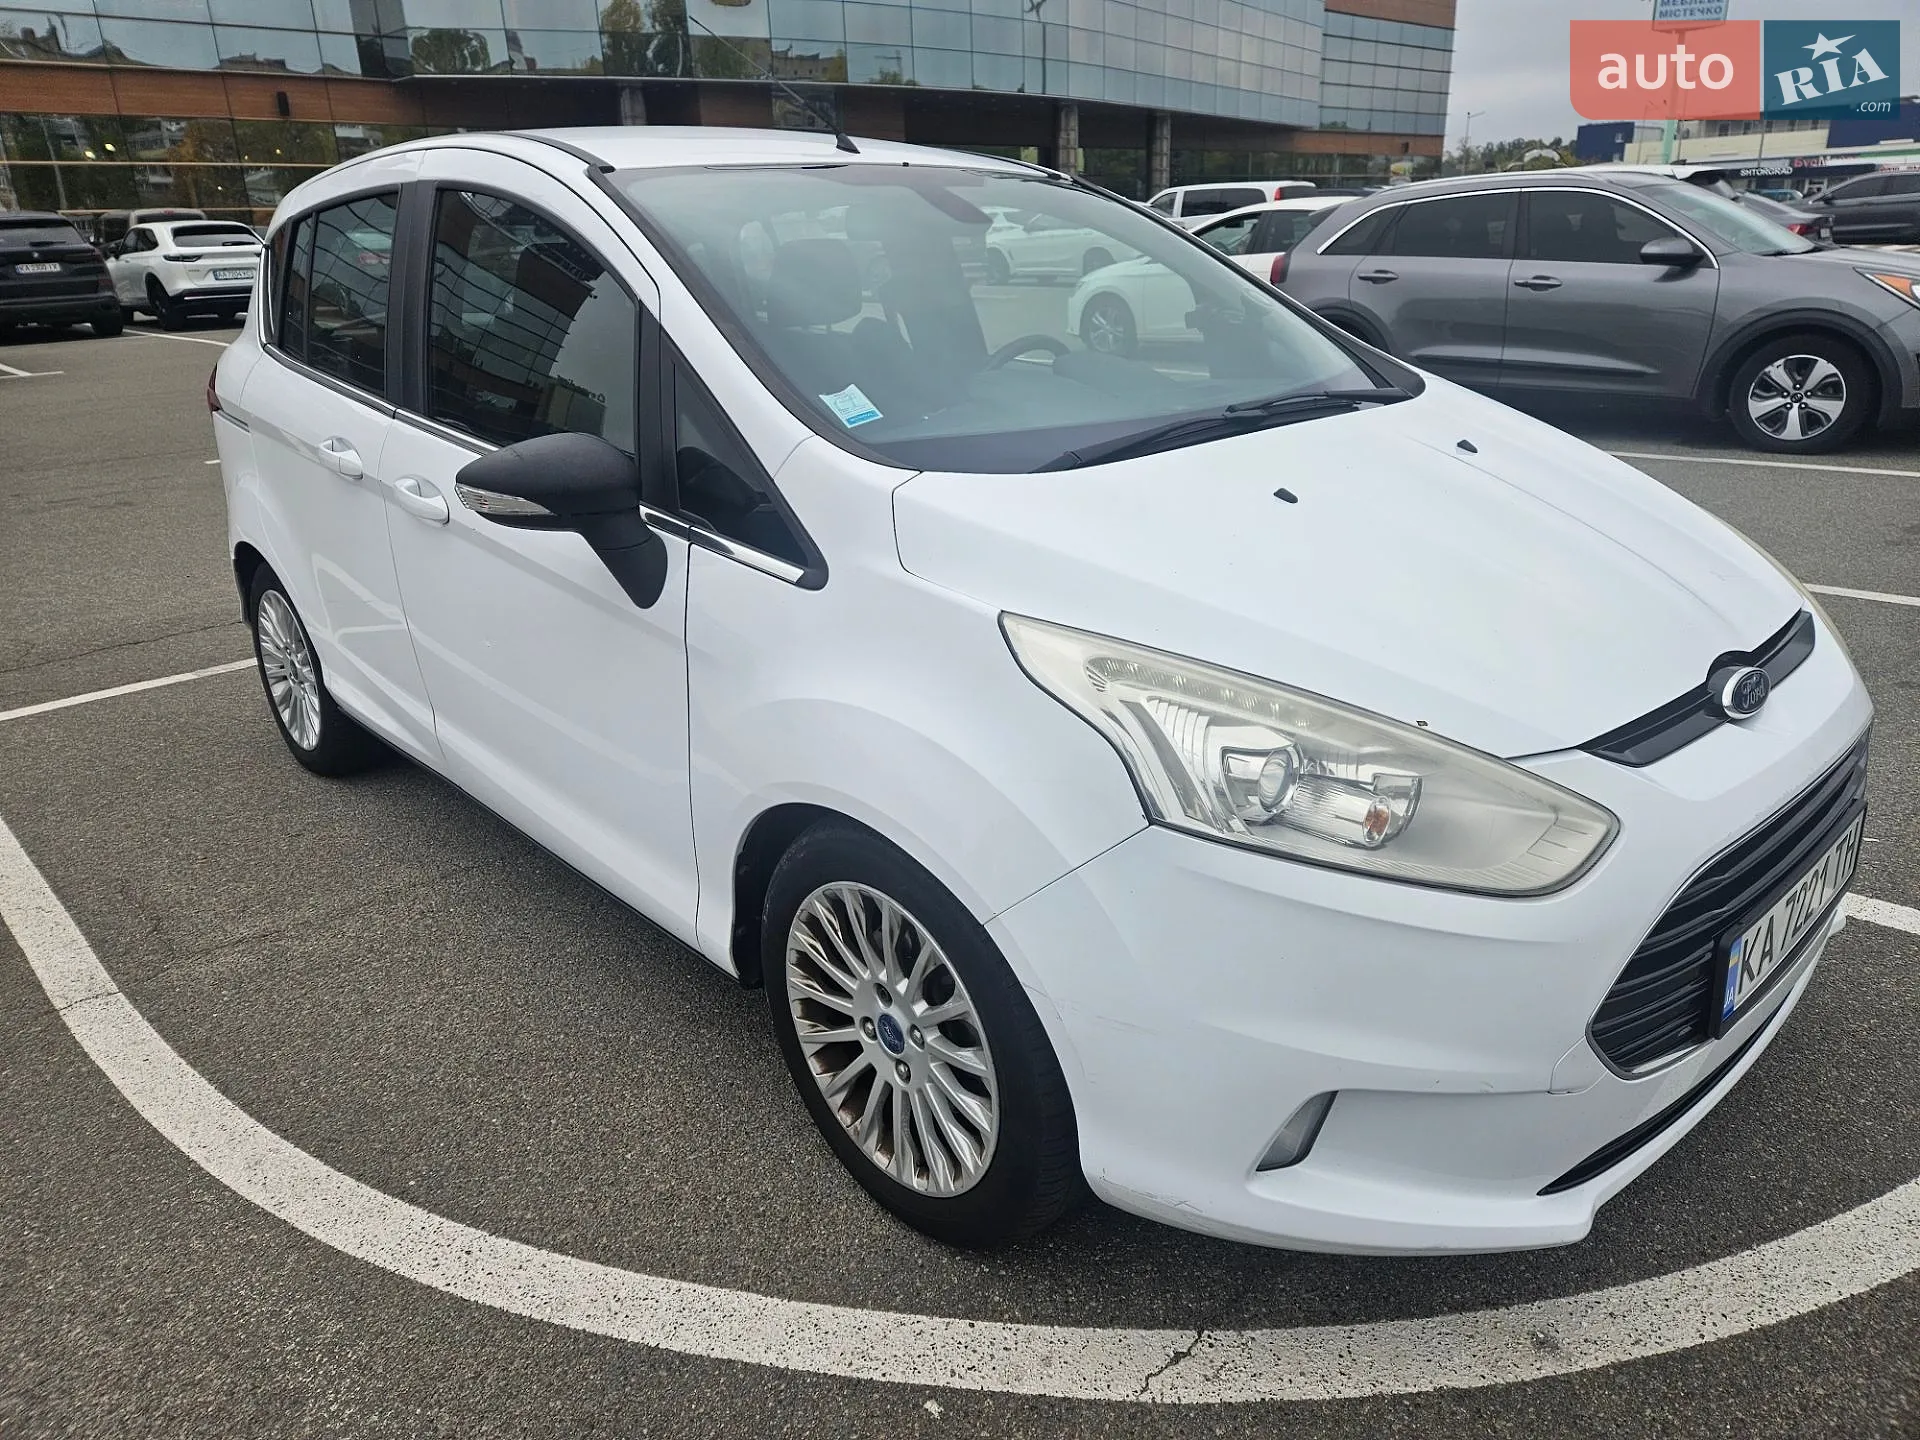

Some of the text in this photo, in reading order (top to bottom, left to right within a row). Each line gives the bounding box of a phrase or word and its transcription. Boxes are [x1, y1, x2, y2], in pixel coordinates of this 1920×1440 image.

[1659, 6, 1723, 18] МІСТЕЧКО
[1739, 821, 1860, 995] KA 7221 TH
